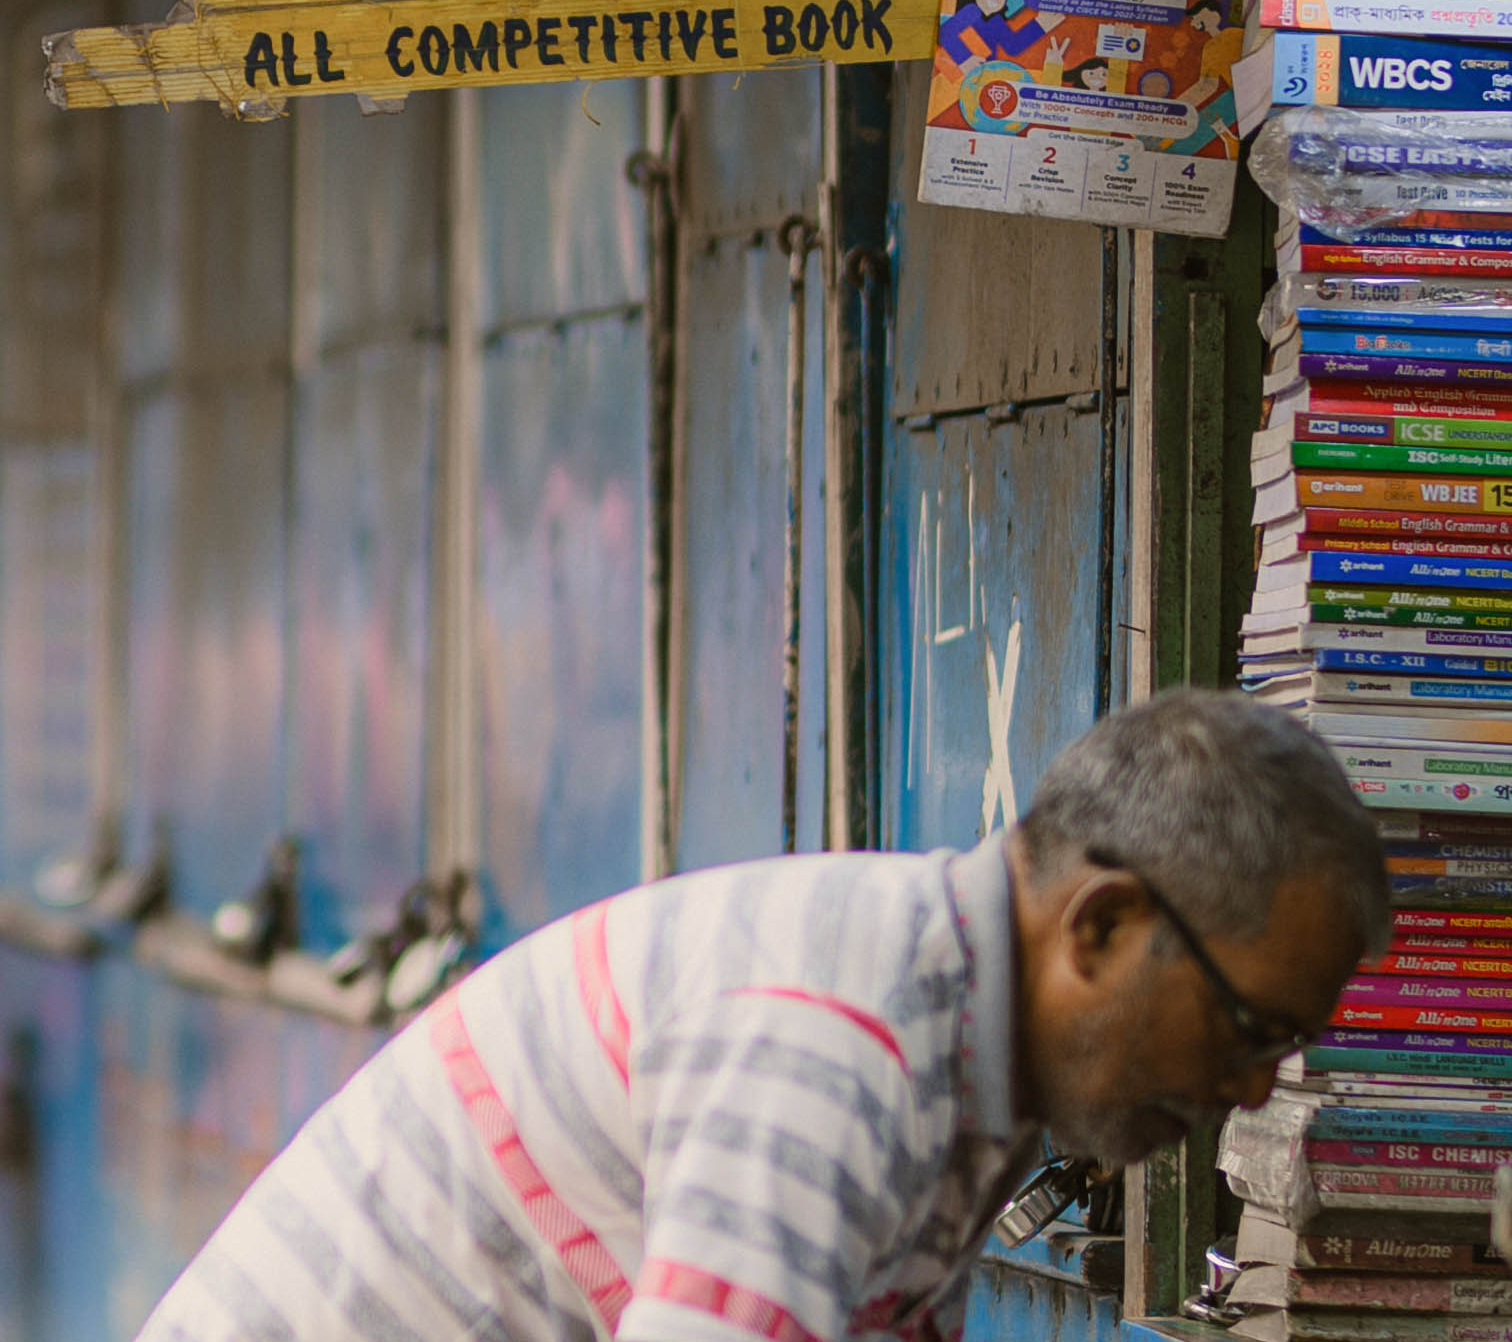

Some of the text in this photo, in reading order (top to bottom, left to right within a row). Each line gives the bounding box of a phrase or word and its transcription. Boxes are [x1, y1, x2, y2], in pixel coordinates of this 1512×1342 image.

[243, 31, 345, 87] ALL
[386, 9, 739, 76] COMPETITIVE
[1349, 57, 1453, 91] WBCS
[1035, 90, 1168, 113] Be Absolutely Exam Ready
[1019, 111, 1069, 122] for Practice
[1020, 100, 1187, 126] With Concepts and 200+ MCQs
[968, 139, 976, 155] 1
[1042, 146, 1056, 164] 2
[950, 158, 988, 168] Extensive
[1116, 154, 1130, 173] 3
[952, 165, 984, 176] Practice
[1038, 167, 1059, 177] Crisp
[1181, 162, 1196, 179] 4
[1030, 175, 1064, 185] Revision
[1104, 173, 1137, 185] Concept
[1106, 182, 1133, 193] Clarity
[1187, 183, 1210, 193] Exam
[1365, 233, 1512, 245] Syllabus for
[1362, 253, 1402, 266] English
[1405, 254, 1456, 266] Grammar
[1364, 384, 1463, 401] Applied English
[1393, 402, 1496, 417] and Composition
[1341, 423, 1445, 442] BOOKS ICSE
[1408, 450, 1438, 464] ISC
[1323, 484, 1363, 493] arihant
[1339, 518, 1497, 535] Middle School English Grammar
[1324, 539, 1489, 555] Primary School English Grammar
[1465, 568, 1500, 578] NCERT
[1456, 596, 1494, 607] NCERT
[1476, 616, 1510, 627] NCERT
[1350, 629, 1483, 645] arihant Laboratory
[1344, 652, 1425, 667] I.S.C. XII
[1358, 682, 1471, 696] arihant Laboratory
[1358, 758, 1481, 773] arihant Laboratory
[1457, 861, 1512, 873] PHYSICS
[1450, 918, 1481, 927] NCERT
[1463, 961, 1500, 971] NCERT
[1466, 987, 1504, 998] NCERT
[1481, 1019, 1512, 1028] NCERT
[1466, 1039, 1501, 1048] NCERT
[1388, 1145, 1420, 1160] ISC
